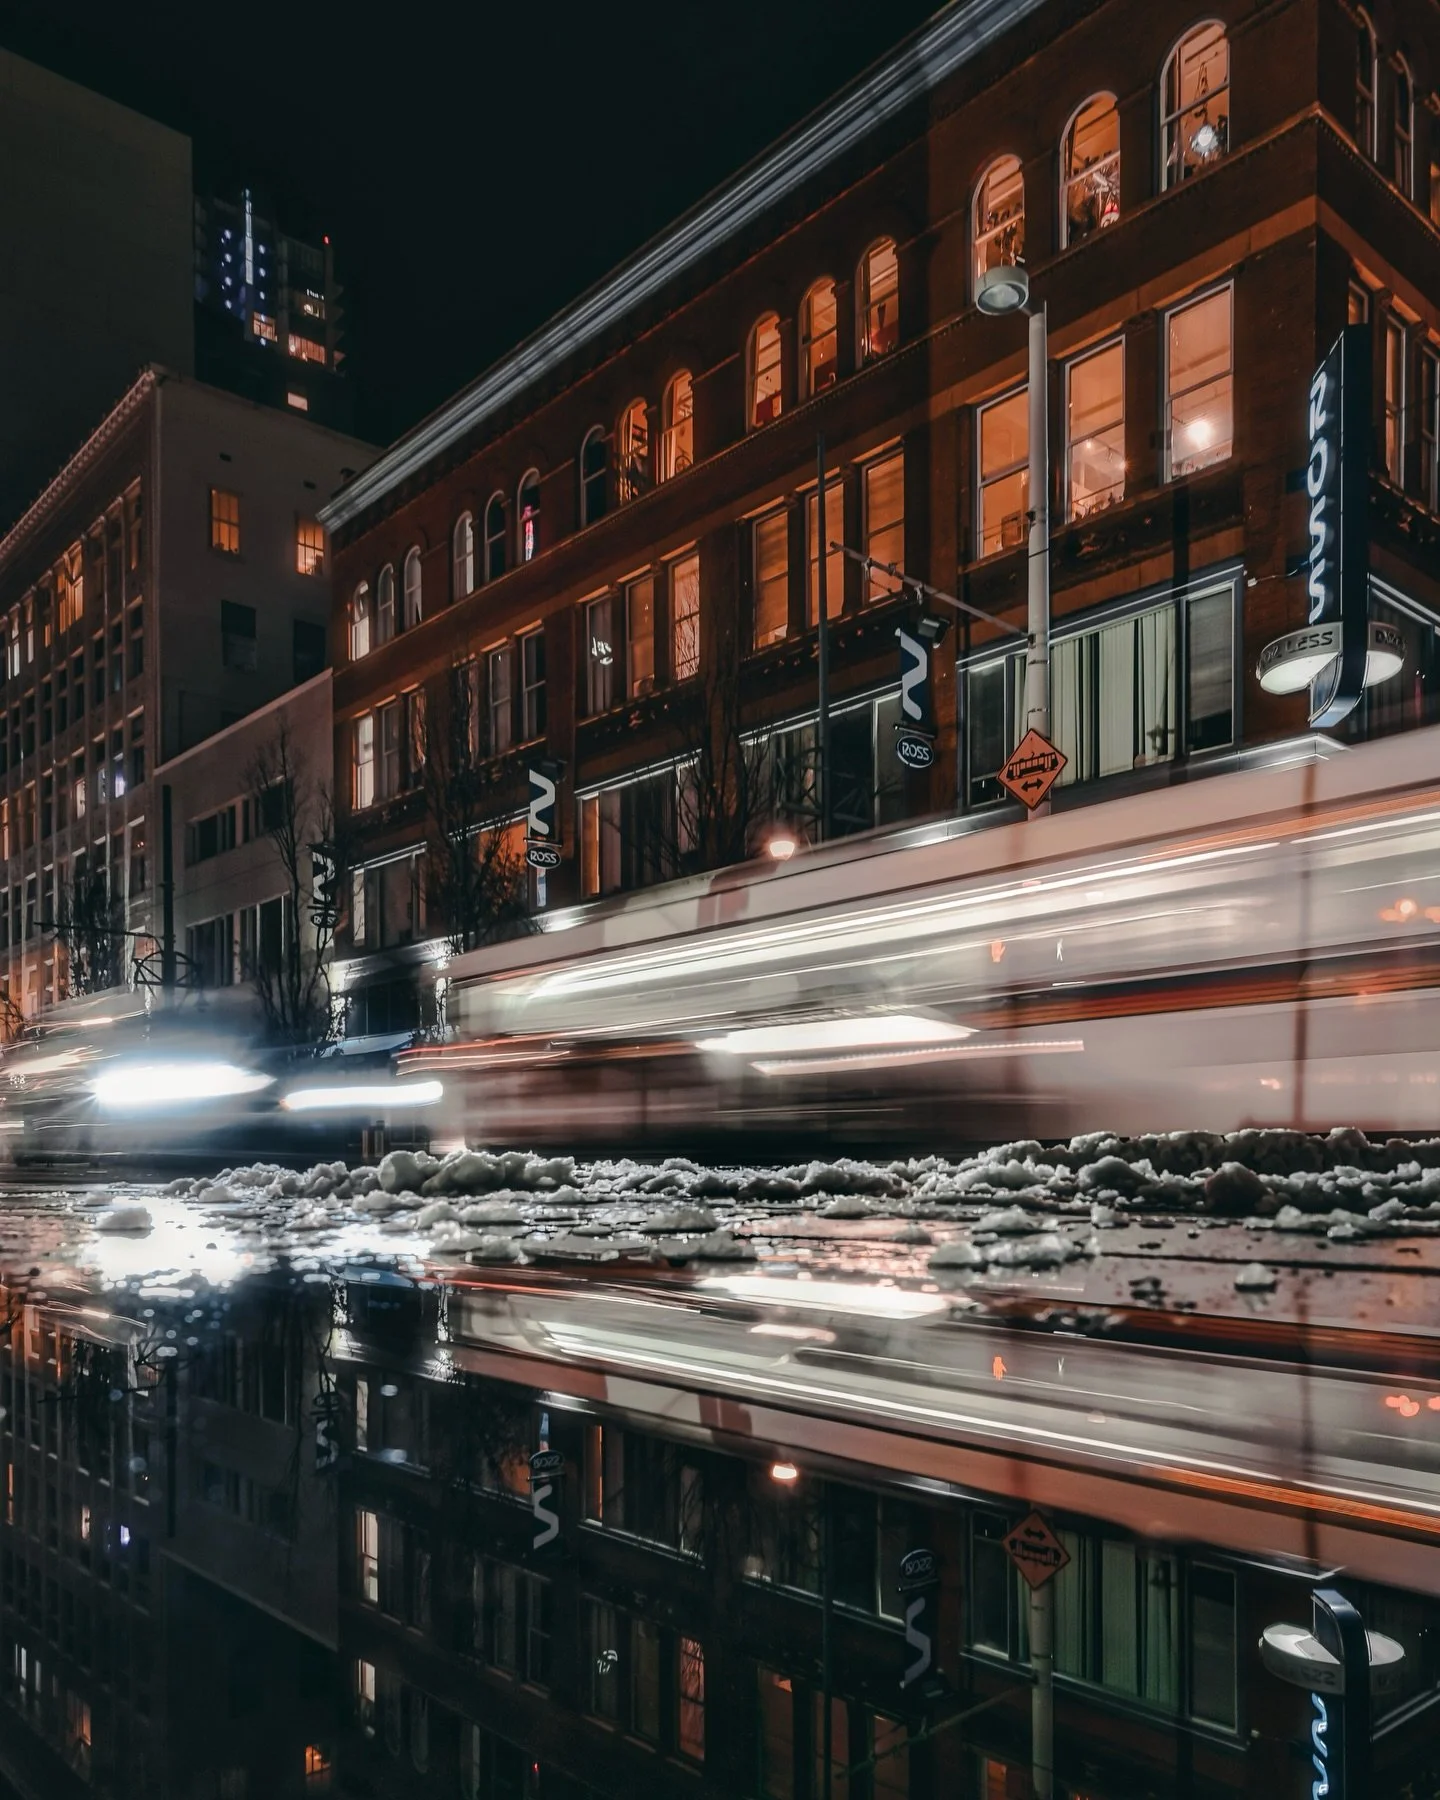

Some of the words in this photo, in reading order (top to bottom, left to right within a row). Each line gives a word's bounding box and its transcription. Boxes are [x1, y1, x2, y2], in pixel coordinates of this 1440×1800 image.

[1307, 370, 1328, 625] ROSS
[1286, 630, 1333, 654] LESS
[902, 741, 930, 761] ROSS
[530, 850, 557, 864] ROSS
